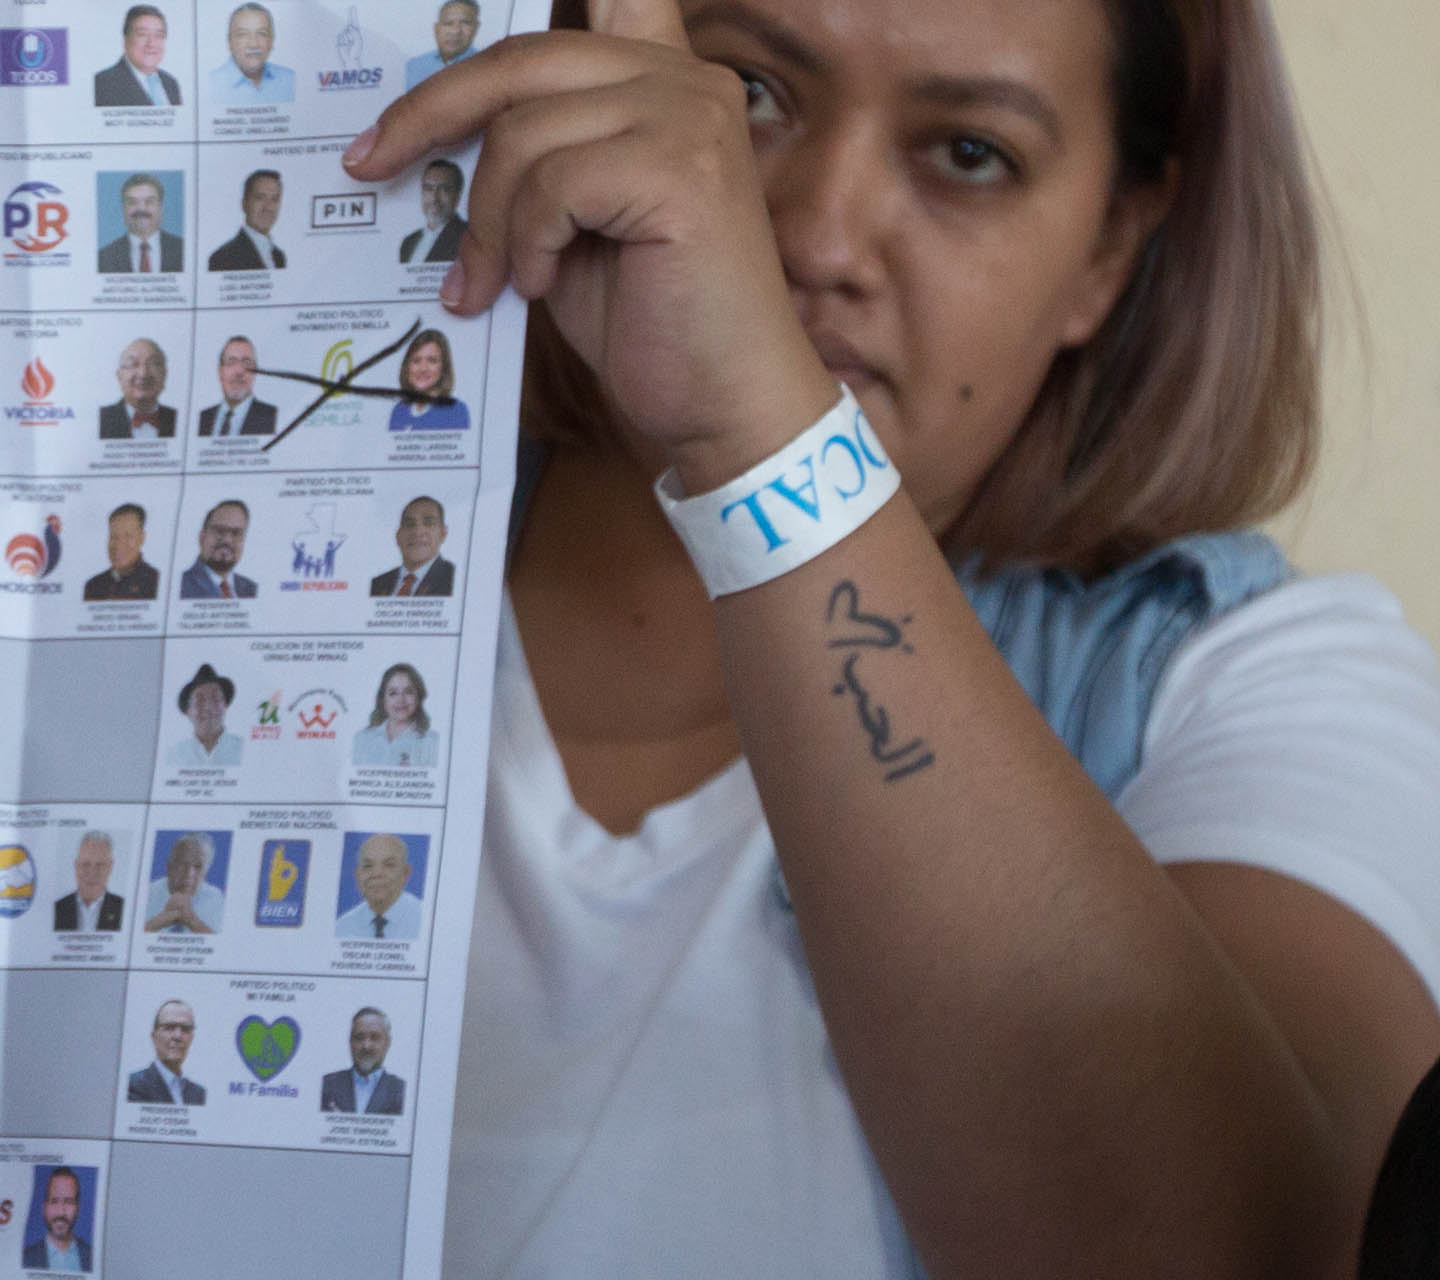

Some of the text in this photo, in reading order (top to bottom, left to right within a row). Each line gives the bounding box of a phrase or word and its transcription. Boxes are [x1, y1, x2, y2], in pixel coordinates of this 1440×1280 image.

[9, 70, 57, 83] TODOS
[317, 67, 383, 87] VAMOS
[323, 201, 366, 218] PIN
[3, 201, 70, 238] PR
[3, 407, 75, 420] VICTORIA
[261, 905, 299, 918] BIEN
[228, 1081, 299, 1099] Mi Familia
